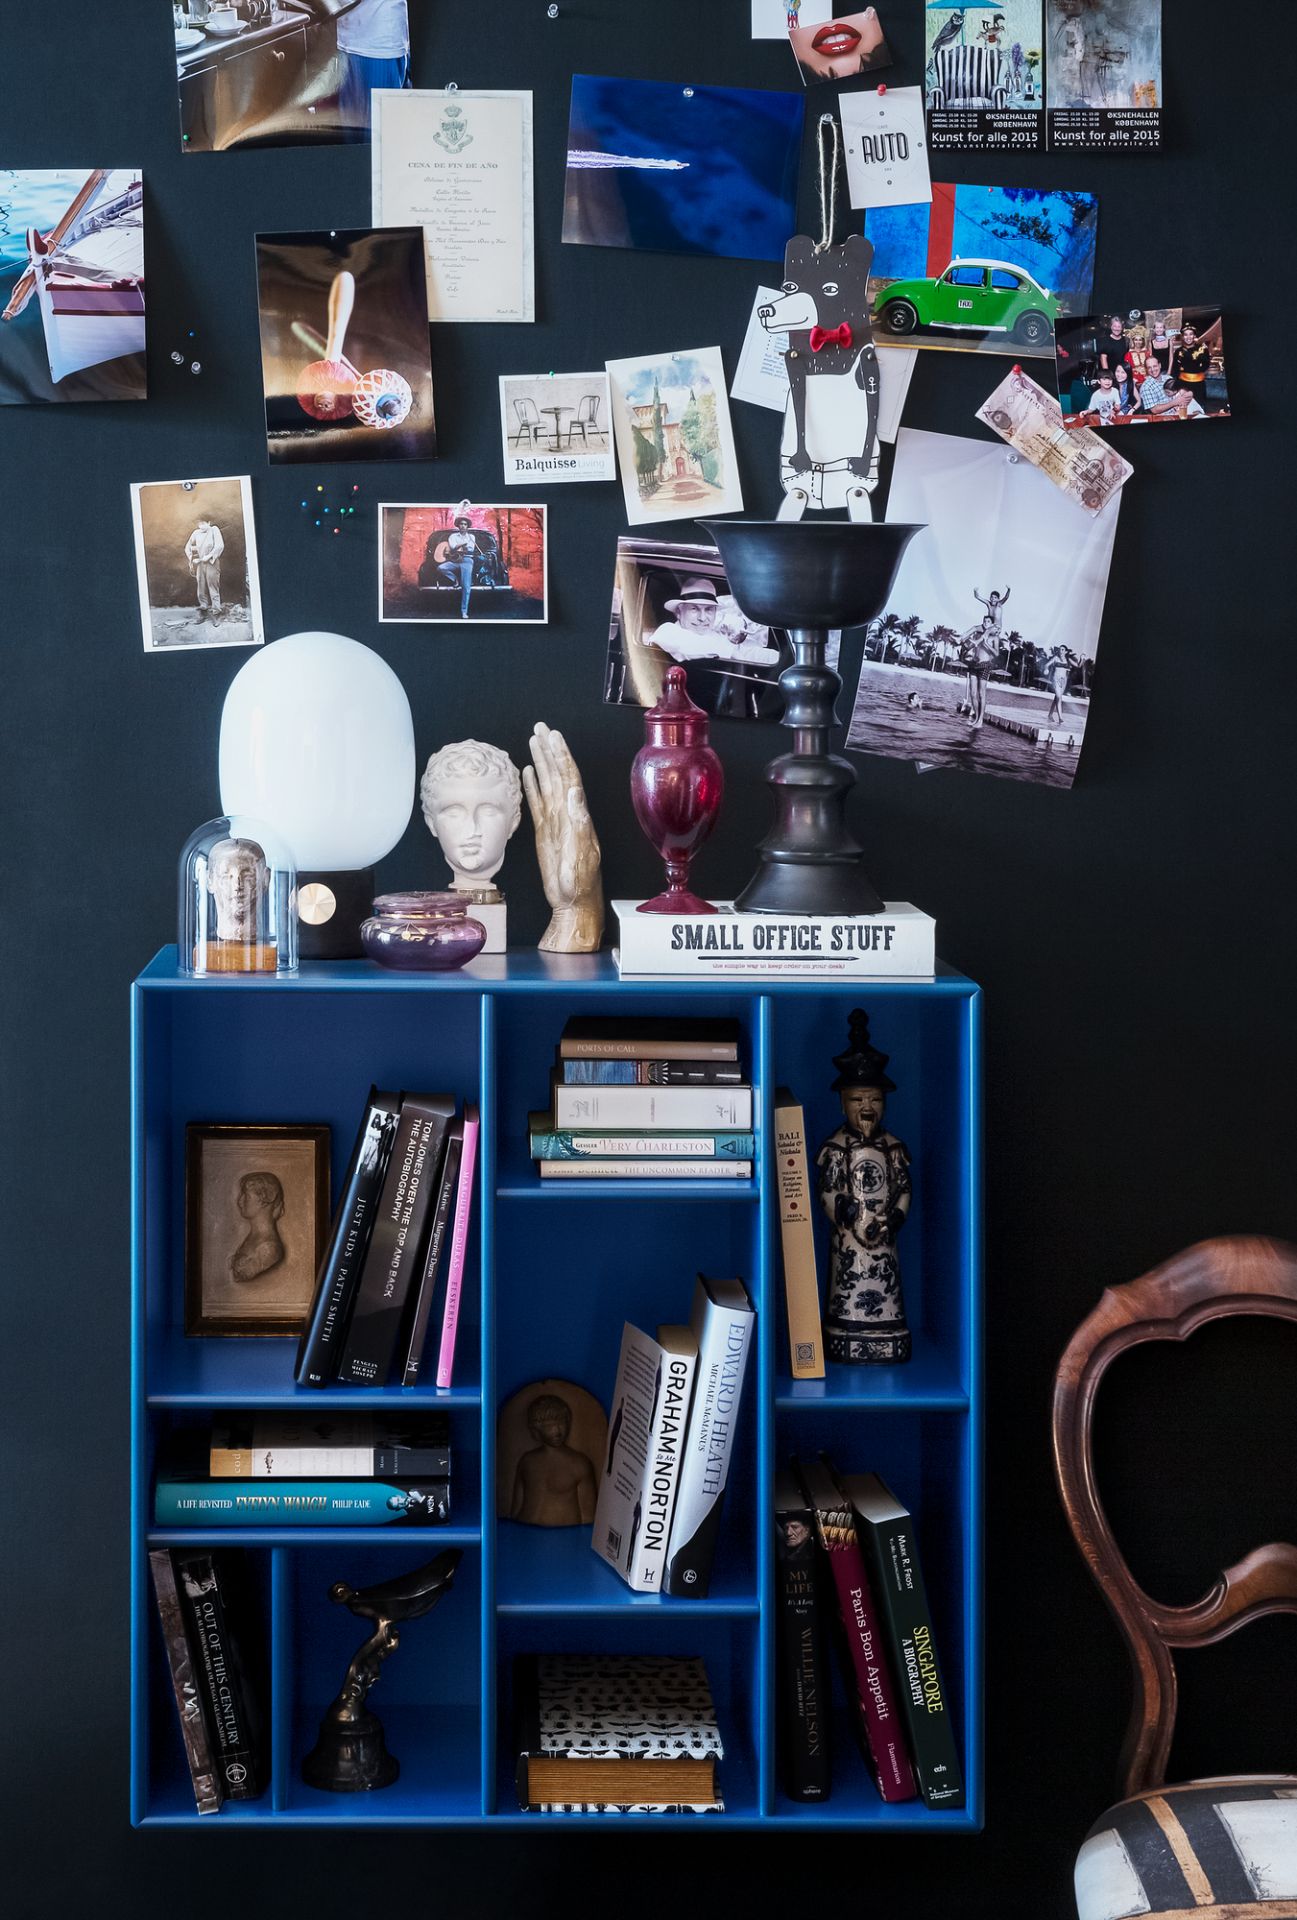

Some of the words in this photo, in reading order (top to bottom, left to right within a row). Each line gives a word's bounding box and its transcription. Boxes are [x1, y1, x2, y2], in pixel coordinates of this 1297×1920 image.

[862, 132, 909, 164] AUTO
[932, 132, 964, 142] Kunst
[968, 132, 983, 141] for
[988, 132, 1007, 141] alle
[1011, 132, 1038, 141] 2015
[1054, 131, 1085, 140] Kunst
[1090, 131, 1105, 140] for
[1110, 131, 1129, 140] alle
[1133, 131, 1160, 140] 2015
[515, 458, 576, 472] Balquisse
[578, 459, 604, 469] Living
[671, 924, 744, 951] SMALL
[752, 925, 822, 950] OFFICE
[831, 925, 896, 951] STUFF
[616, 1045, 635, 1053] CALL
[411, 1119, 422, 1137] THE
[422, 1122, 432, 1142] TOM
[778, 1132, 800, 1140] BALI
[413, 1144, 426, 1176] JONES
[391, 1138, 416, 1221] AUTOBIOGRAPHY
[406, 1178, 419, 1204] OVER
[353, 1197, 366, 1226] JUST
[440, 1191, 449, 1211] skrive
[457, 1171, 469, 1233] MARGUERITE
[401, 1206, 413, 1225] THE
[344, 1231, 358, 1257] KIDS
[397, 1228, 408, 1246] TOP
[431, 1221, 444, 1256] Marguerite
[391, 1247, 402, 1268] AND
[453, 1237, 462, 1268] DURAS
[428, 1257, 438, 1278] Duras
[333, 1268, 348, 1301] PATTI
[384, 1270, 398, 1298] BACK
[322, 1306, 338, 1342] SMITH
[352, 1365, 376, 1374] MICHAEL
[353, 1359, 378, 1368] PENGUIN
[716, 1323, 746, 1414] EDWARD
[704, 1363, 718, 1405] MICHAEL
[659, 1361, 688, 1455] GRAHAM
[702, 1421, 729, 1495] HEATH
[176, 1500, 182, 1508] A
[182, 1500, 197, 1508] LIFE
[199, 1500, 232, 1508] REVISITED
[236, 1496, 282, 1511] EVELYN
[284, 1496, 328, 1511] WAUGH
[332, 1500, 352, 1508] PHILIP
[354, 1500, 371, 1508] EADE
[643, 1462, 672, 1550] NORTON
[790, 1570, 808, 1581] MY
[902, 1558, 910, 1567] R.
[786, 1583, 814, 1594] LIFE
[904, 1568, 913, 1590] FROST
[203, 1602, 218, 1629] OUT
[208, 1633, 222, 1650] OF
[801, 1627, 815, 1682] WILLIE
[850, 1587, 866, 1628] Paris
[860, 1632, 874, 1662] Bon
[868, 1666, 889, 1720] Appetit
[902, 1638, 910, 1647] A
[213, 1654, 228, 1684] THIS
[903, 1648, 924, 1706] BIOGRAPHY
[914, 1626, 944, 1713] SINGAPORE
[219, 1687, 240, 1745] CENTURY
[805, 1688, 819, 1756] NELSON
[888, 1742, 900, 1784] Flammarion
